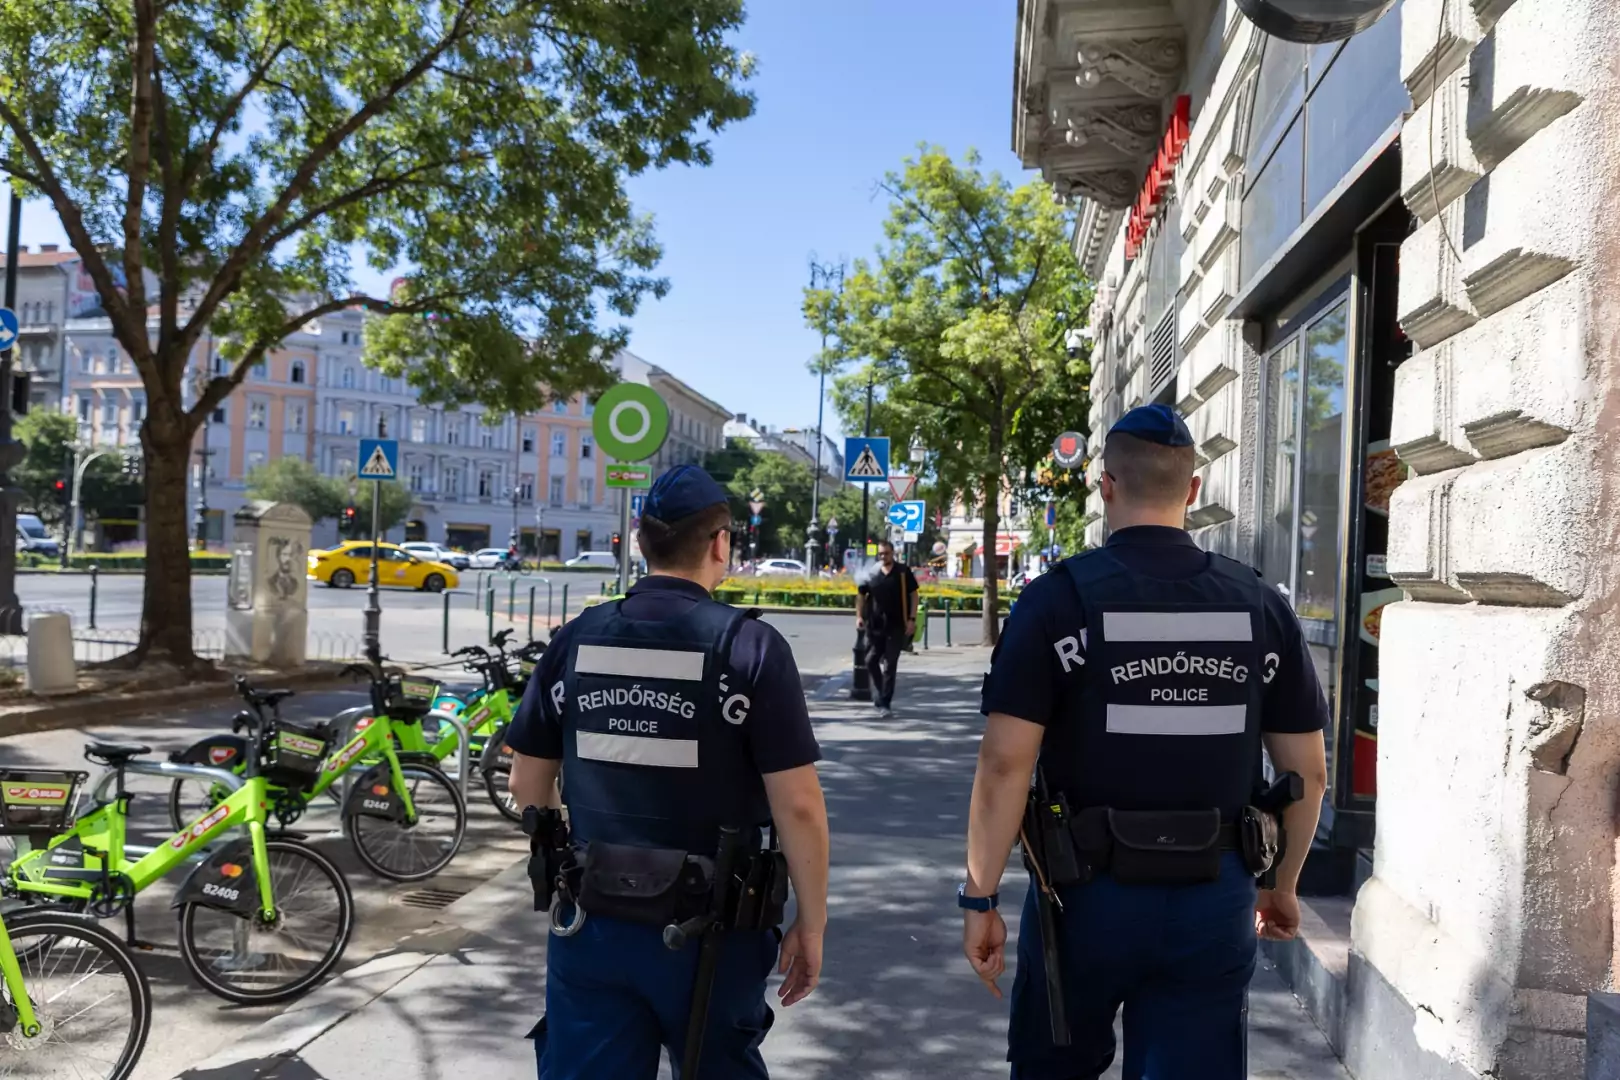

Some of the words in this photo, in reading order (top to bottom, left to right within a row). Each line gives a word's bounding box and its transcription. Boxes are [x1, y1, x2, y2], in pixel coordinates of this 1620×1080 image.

[1111, 651, 1249, 685] RENDŐRSÉG
[577, 684, 696, 719] RENDŐRSÉG
[1151, 688, 1209, 701] POLICE
[608, 718, 658, 733] POLICE
[203, 883, 240, 900] 82408
